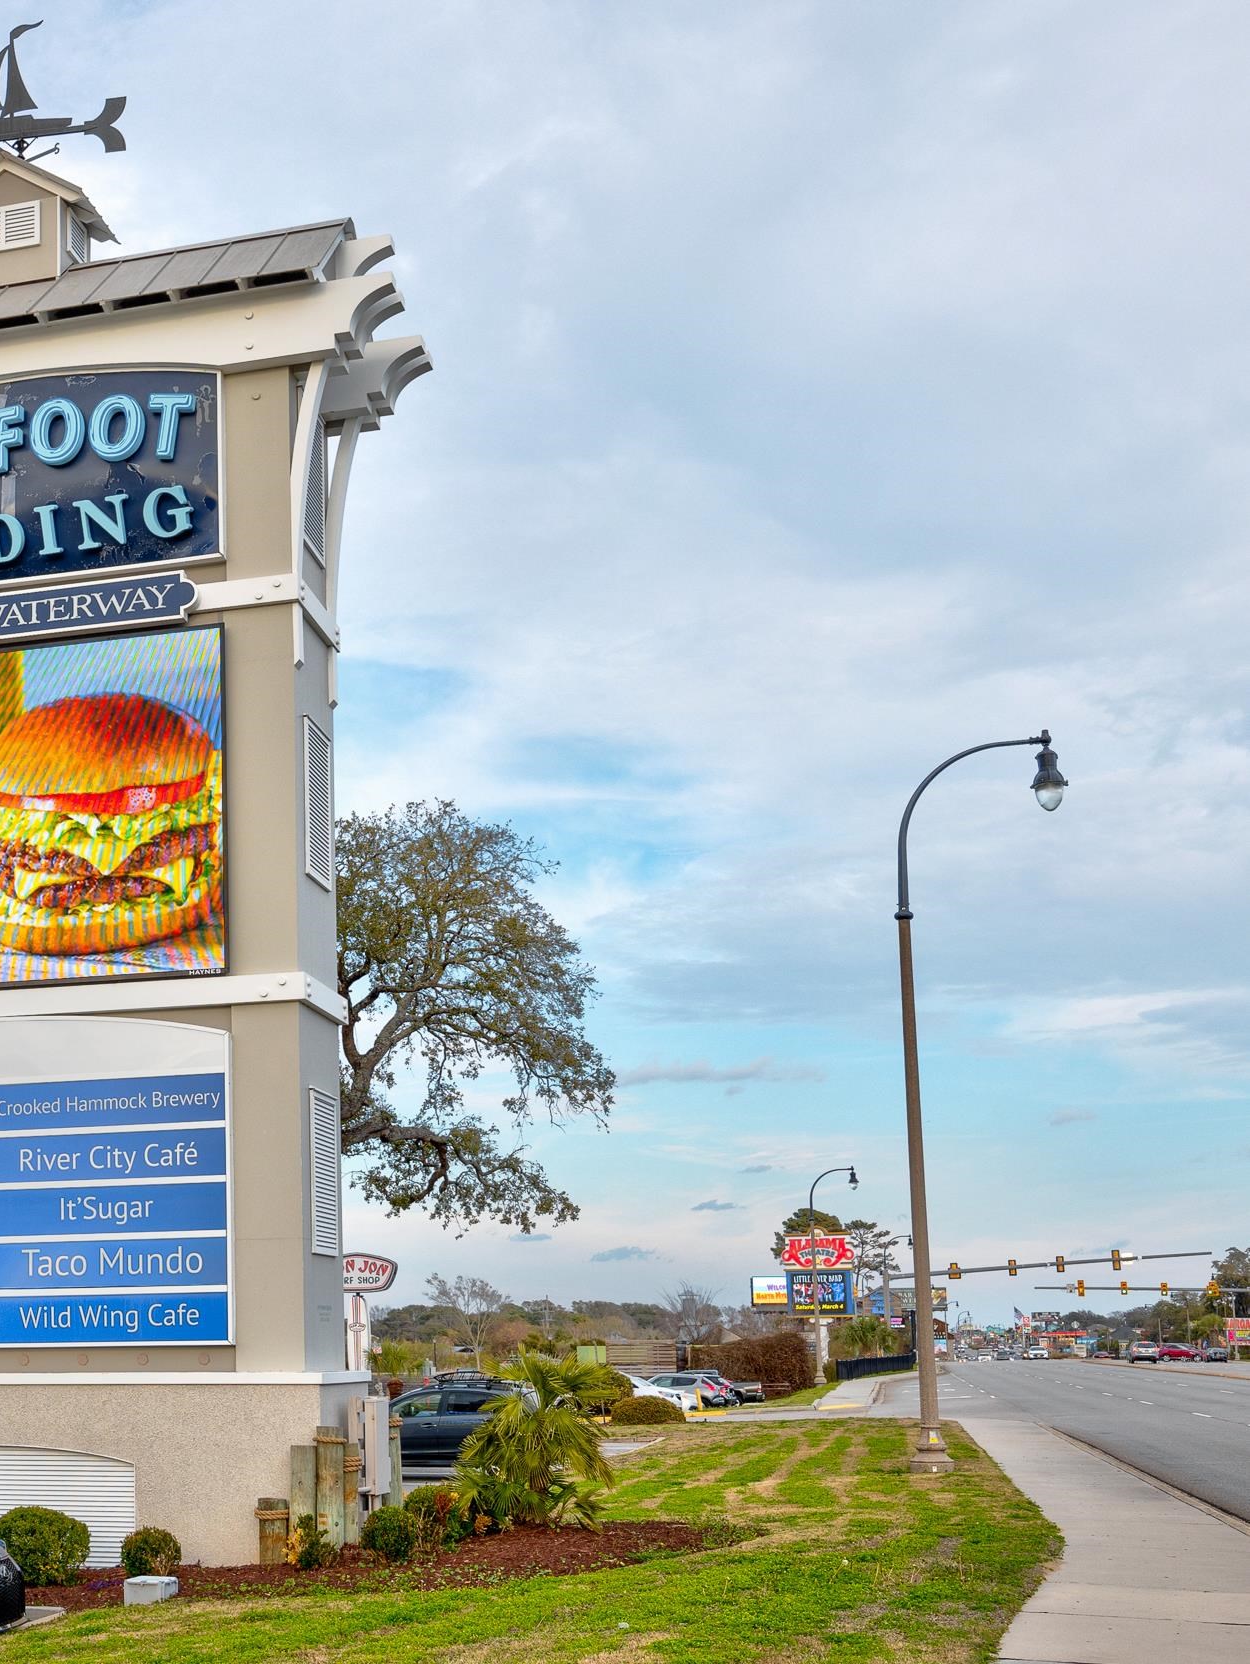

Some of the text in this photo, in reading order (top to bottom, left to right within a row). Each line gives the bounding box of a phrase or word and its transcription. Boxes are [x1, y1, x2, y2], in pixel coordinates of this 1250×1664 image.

[189, 968, 221, 976] HAYNES
[66, 1093, 147, 1112] Hammock
[152, 1091, 220, 1109] Brewery
[19, 1141, 198, 1174] River City Café
[60, 1196, 154, 1225] It'Sugar
[21, 1245, 203, 1277] Taco Mundo
[799, 1248, 836, 1258] THATRE
[358, 1260, 389, 1276] JON
[357, 1276, 380, 1284] SHOP
[19, 1303, 200, 1332] Wild Wing Cafe
